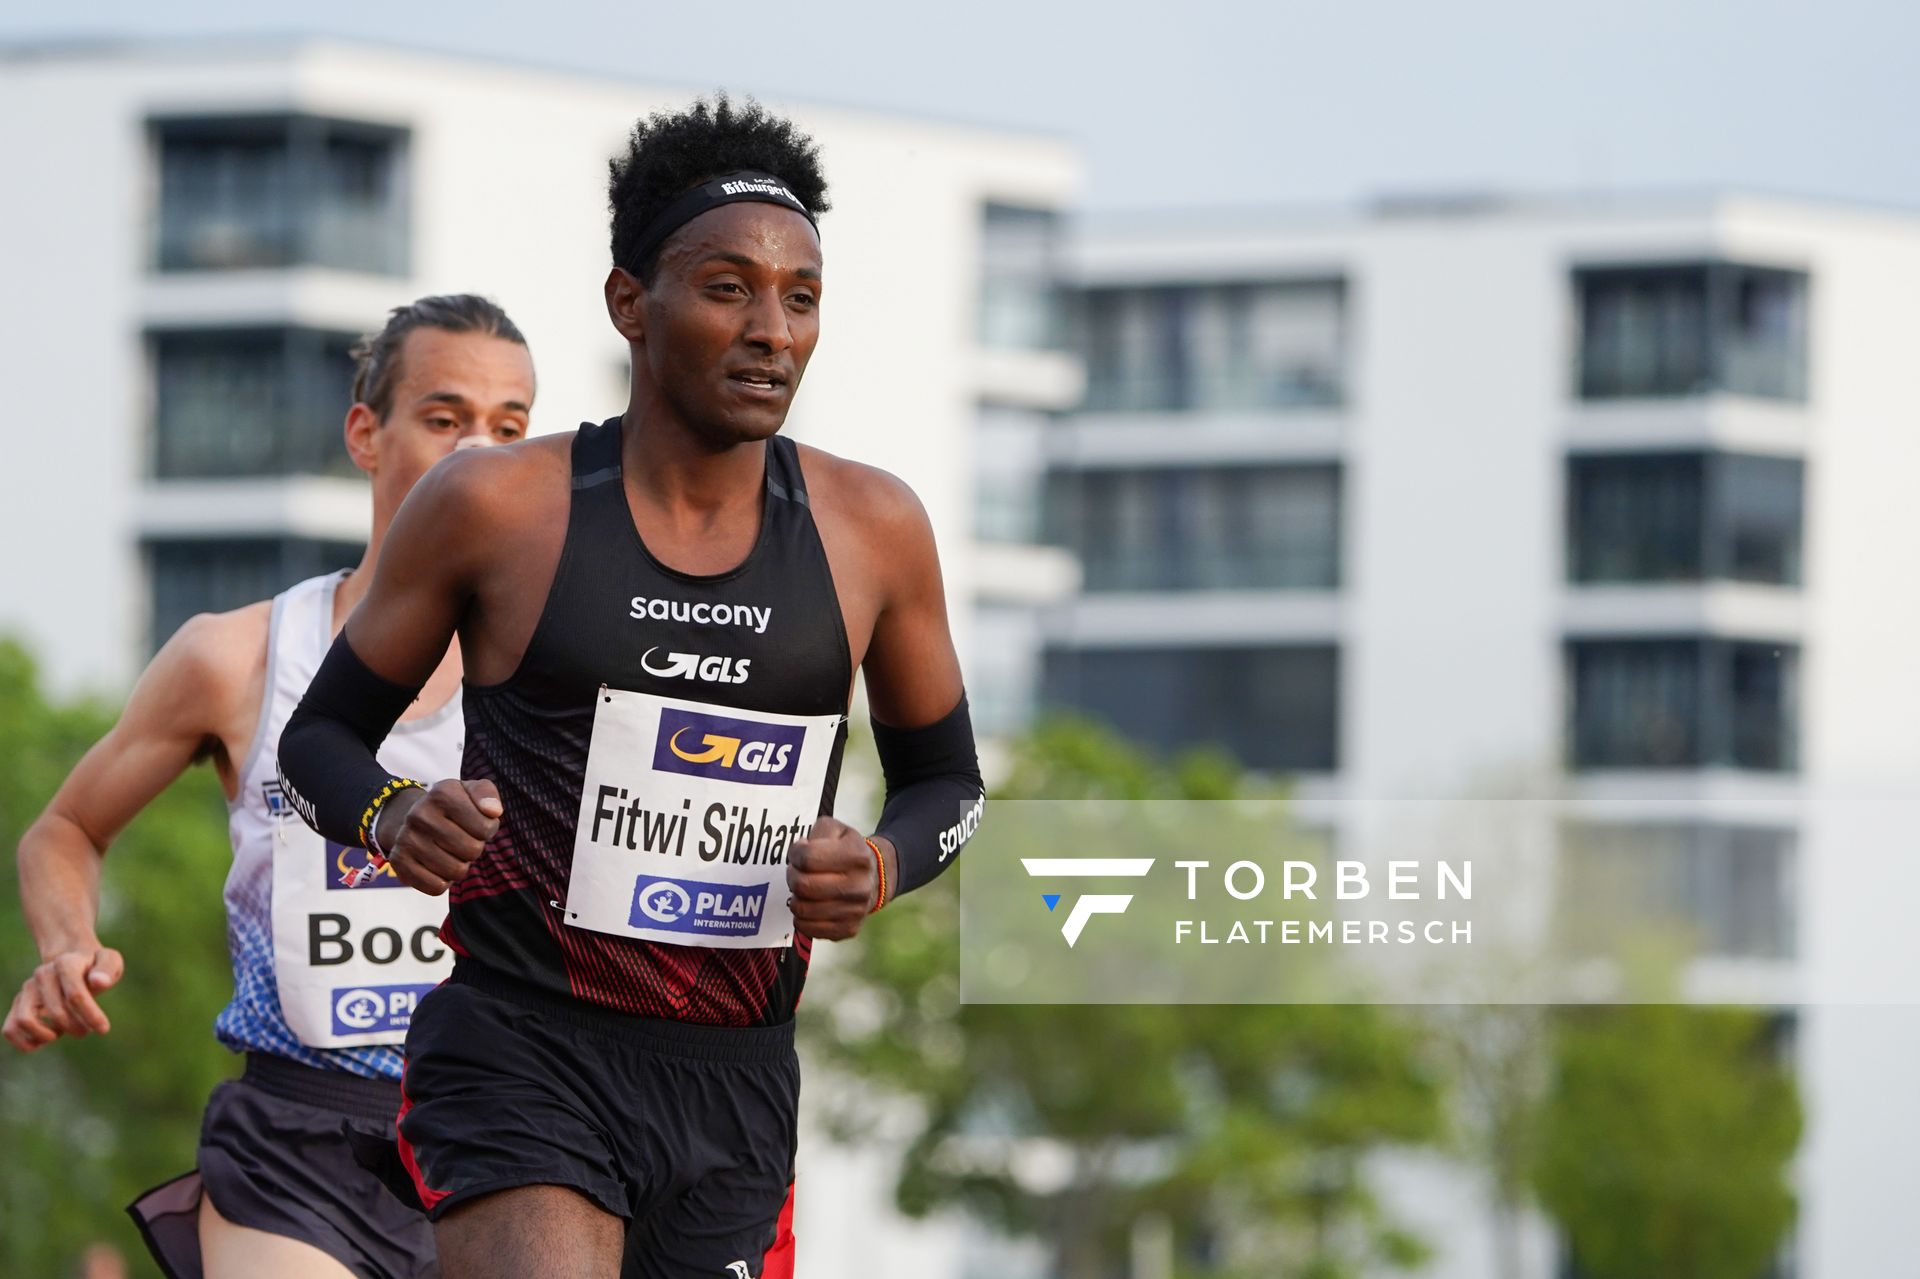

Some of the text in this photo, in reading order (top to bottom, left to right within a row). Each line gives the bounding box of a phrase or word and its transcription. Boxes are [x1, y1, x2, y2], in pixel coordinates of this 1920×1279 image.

[721, 179, 784, 196] Bitburger
[629, 596, 772, 634] saucony
[698, 655, 751, 684] GLS
[737, 741, 793, 773] GLS
[591, 784, 691, 857] Fitwi
[695, 892, 762, 917] PLAN
[693, 918, 756, 929] INTERNATIONAL
[308, 913, 456, 967] Boc
